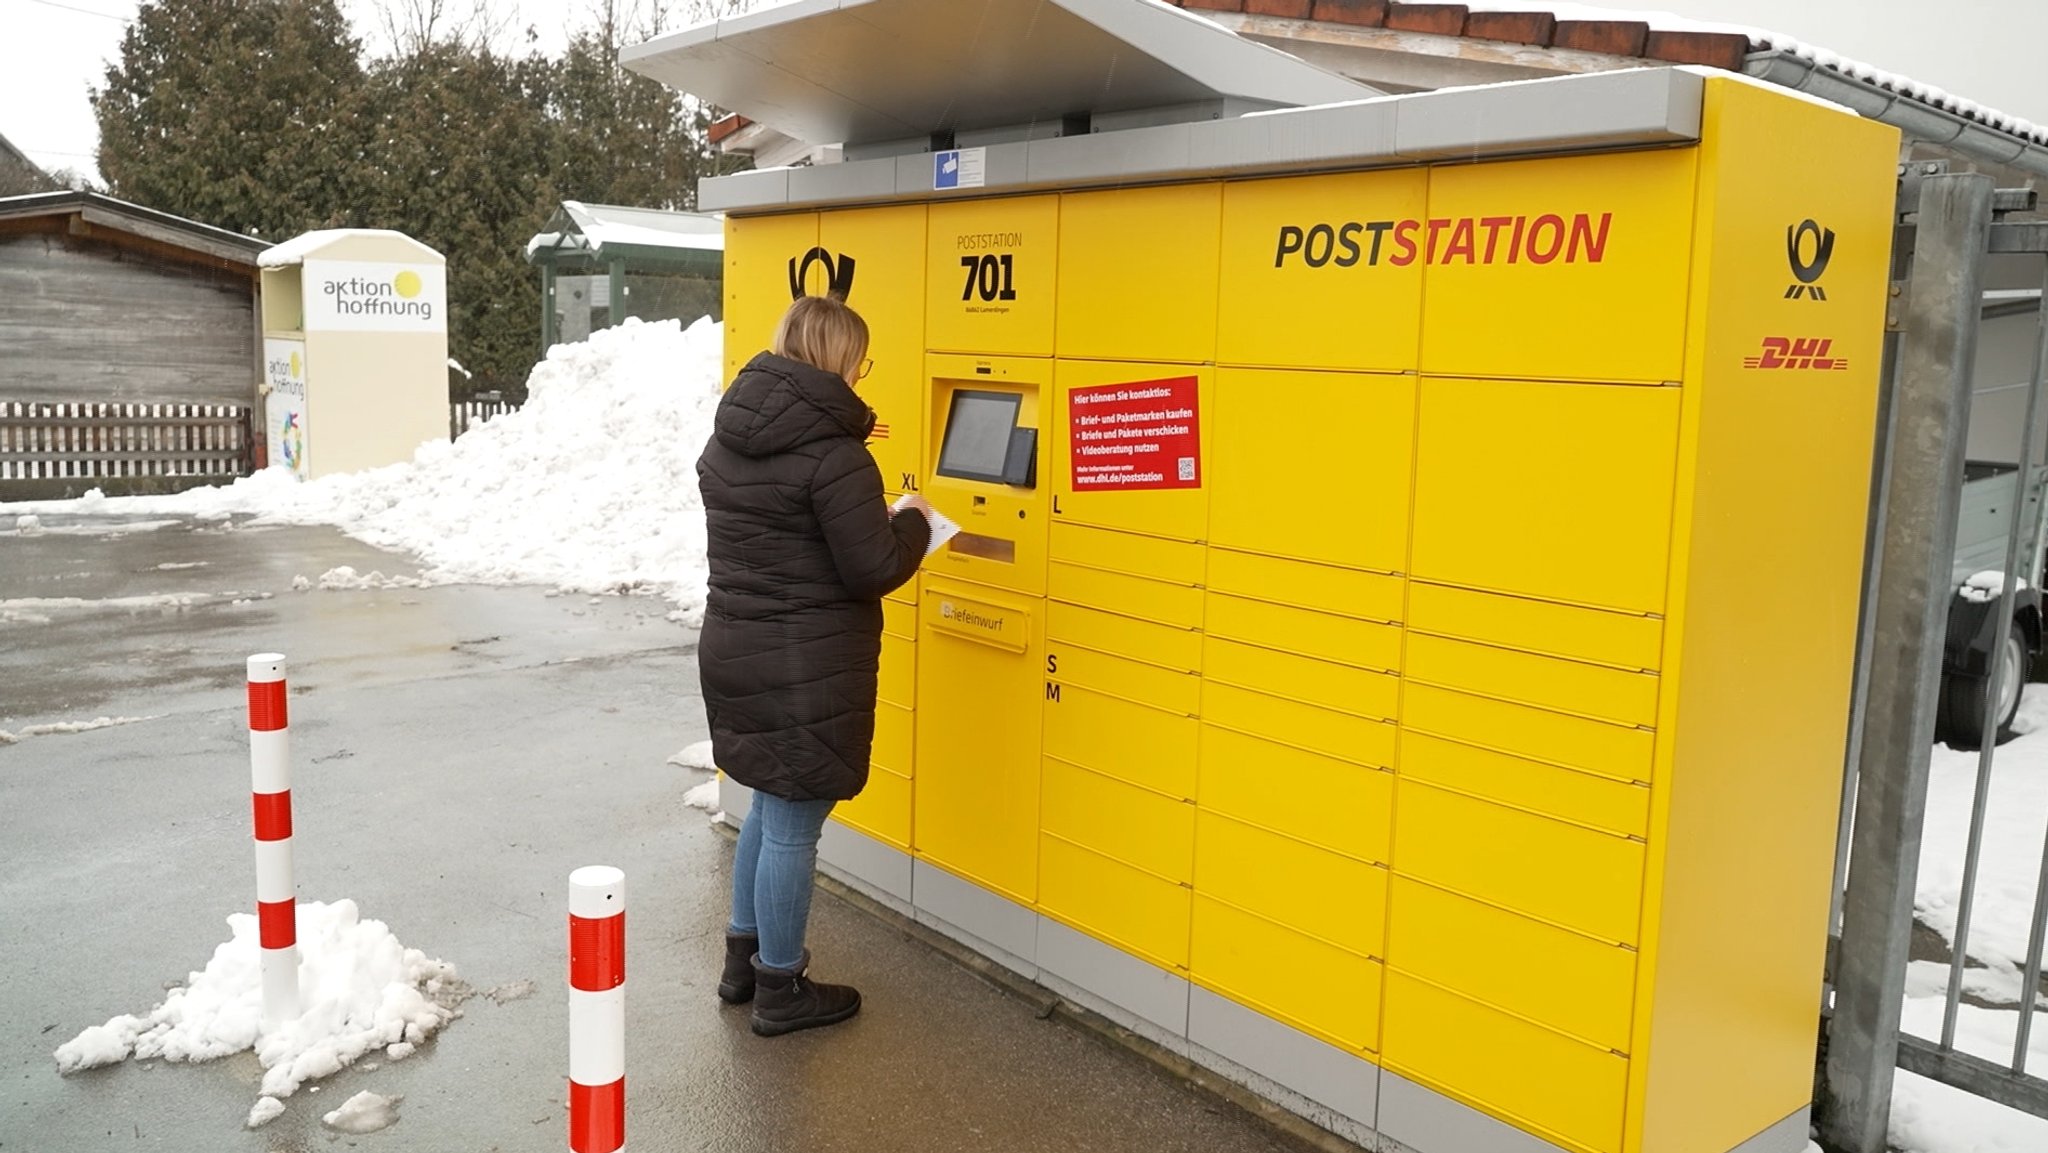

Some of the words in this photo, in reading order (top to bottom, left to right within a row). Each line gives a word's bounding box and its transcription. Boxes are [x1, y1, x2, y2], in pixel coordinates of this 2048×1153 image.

[957, 232, 1022, 250] POSTSTATION
[1275, 213, 1612, 268] POSTSTATION
[324, 278, 392, 296] aktion
[961, 254, 1016, 301] 701
[337, 298, 431, 320] hoffnung
[1758, 337, 1833, 370] DHL
[1074, 394, 1089, 405] Hier
[1090, 391, 1116, 403] können
[1116, 391, 1129, 401] Sie
[1129, 387, 1171, 399] kontaktlos:
[1081, 414, 1100, 426] Brief-
[1101, 413, 1116, 424] und
[1116, 411, 1165, 422] Paketmarken
[1166, 407, 1193, 419] kaufen
[1081, 430, 1102, 441] Briefe
[1103, 428, 1117, 439] und
[1118, 427, 1143, 438] Pakete
[1144, 425, 1188, 436] verschicken
[1082, 445, 1133, 456] Videoberatung
[1134, 443, 1160, 453] nutzen
[902, 472, 919, 492] XL
[1077, 472, 1163, 485] www.dhl.de/poststation
[1053, 494, 1062, 514] L
[1047, 654, 1057, 674] S
[1046, 681, 1060, 703] M
